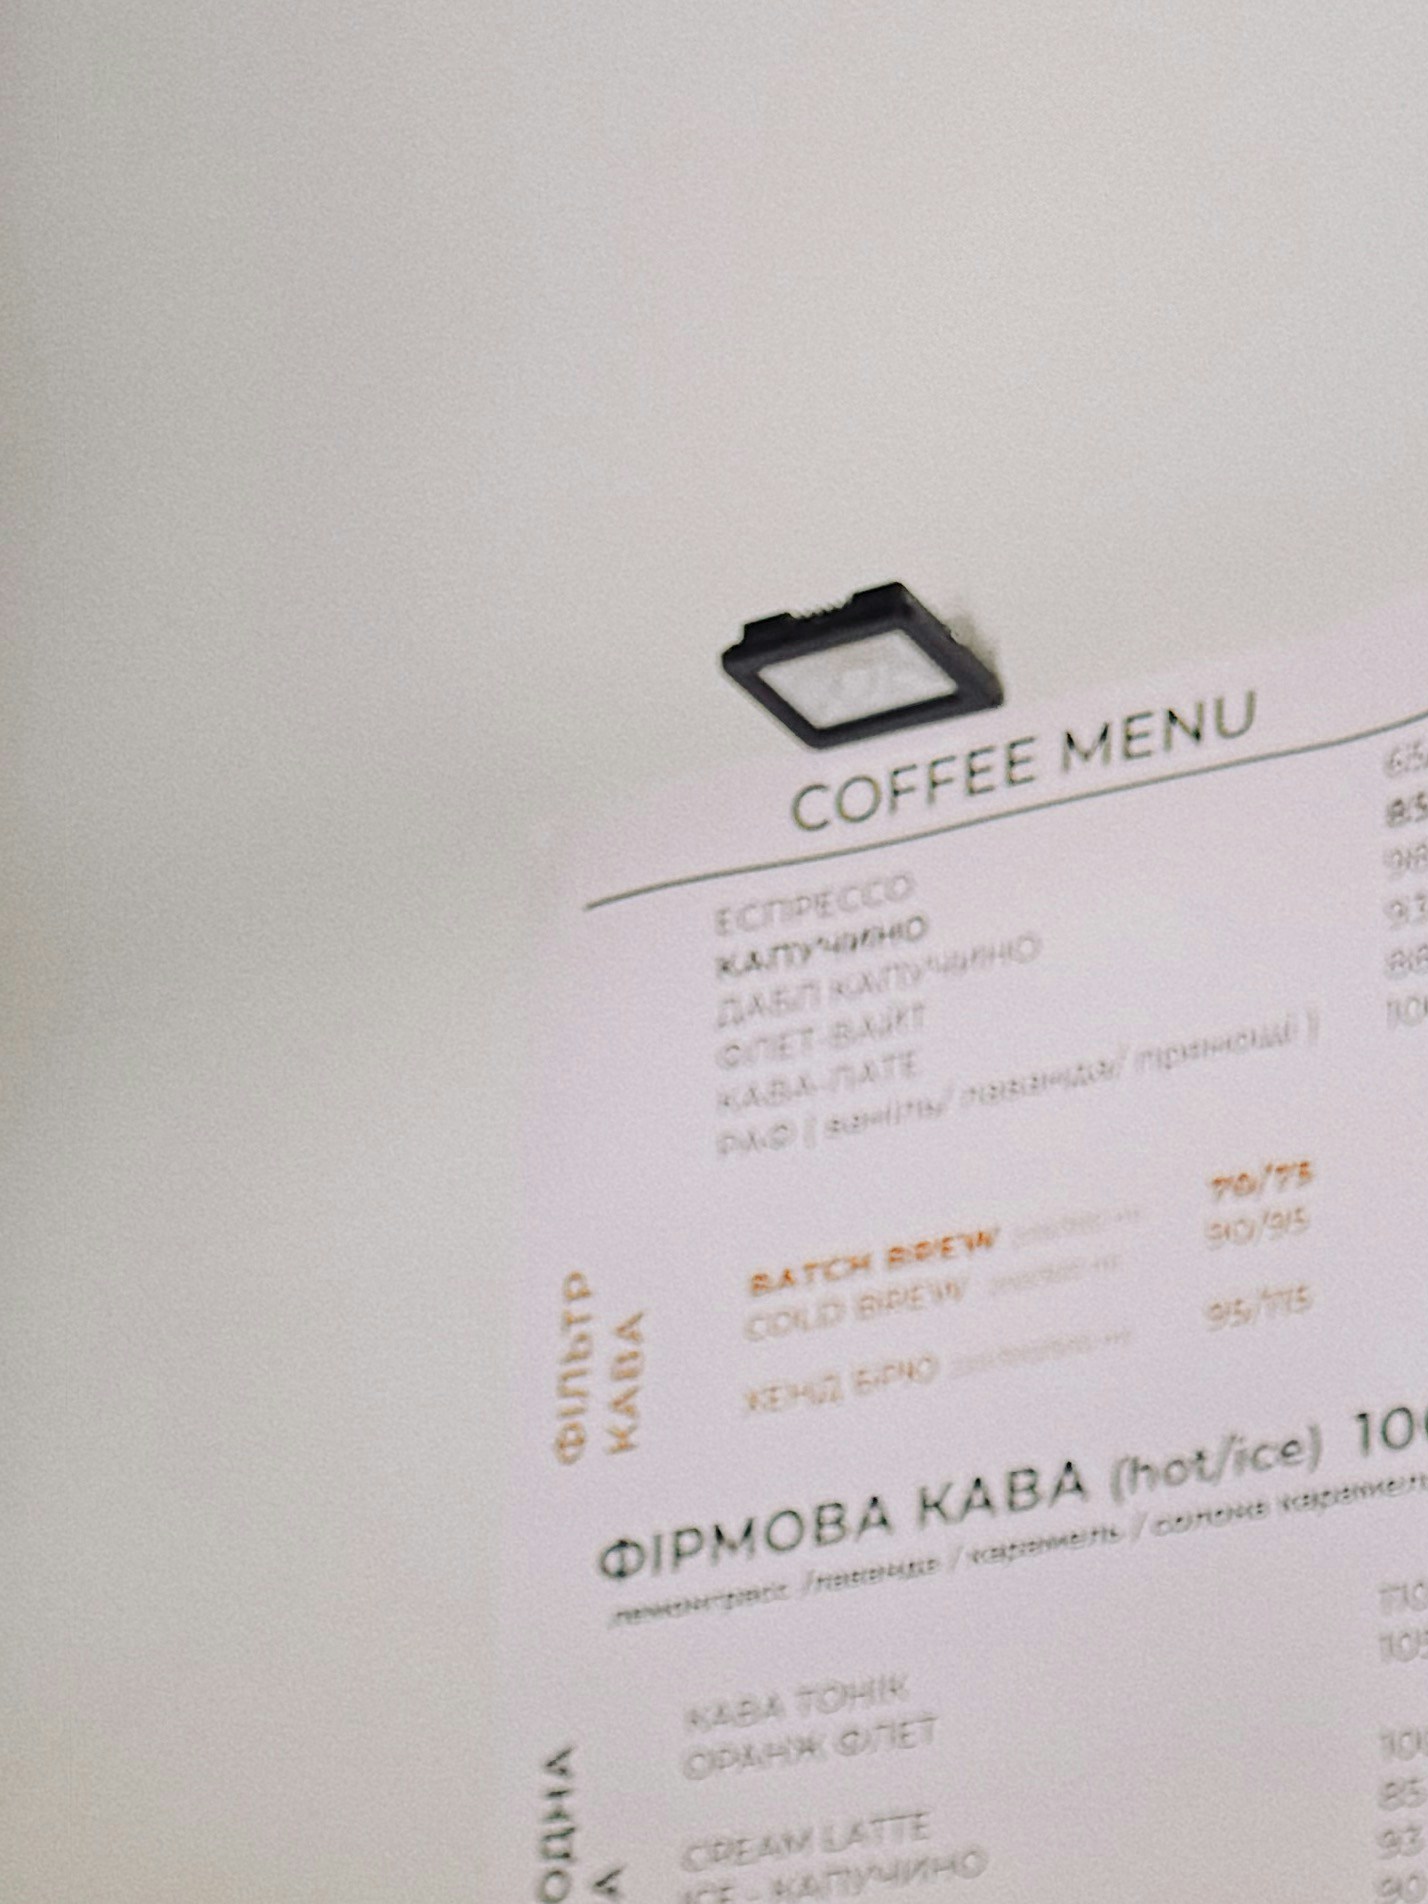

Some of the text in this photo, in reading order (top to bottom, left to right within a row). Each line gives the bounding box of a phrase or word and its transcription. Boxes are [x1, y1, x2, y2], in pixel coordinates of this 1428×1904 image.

[791, 689, 1257, 832] COFFEE MENU
[716, 914, 930, 981] КАПУЧИНО
[749, 1250, 872, 1298] BATCH
[884, 1225, 1001, 1272] BREW
[743, 1295, 846, 1342] COLD
[552, 1268, 594, 1467] ФІЛЬТР
[605, 1310, 648, 1457] КАВА
[598, 1494, 894, 1582] ФІРМОВА
[915, 1460, 1089, 1530] КАВА
[1109, 1424, 1324, 1508] (hot/ice)
[684, 1670, 912, 1734] КАВА ТОНІК
[681, 1825, 814, 1873] CREAM
